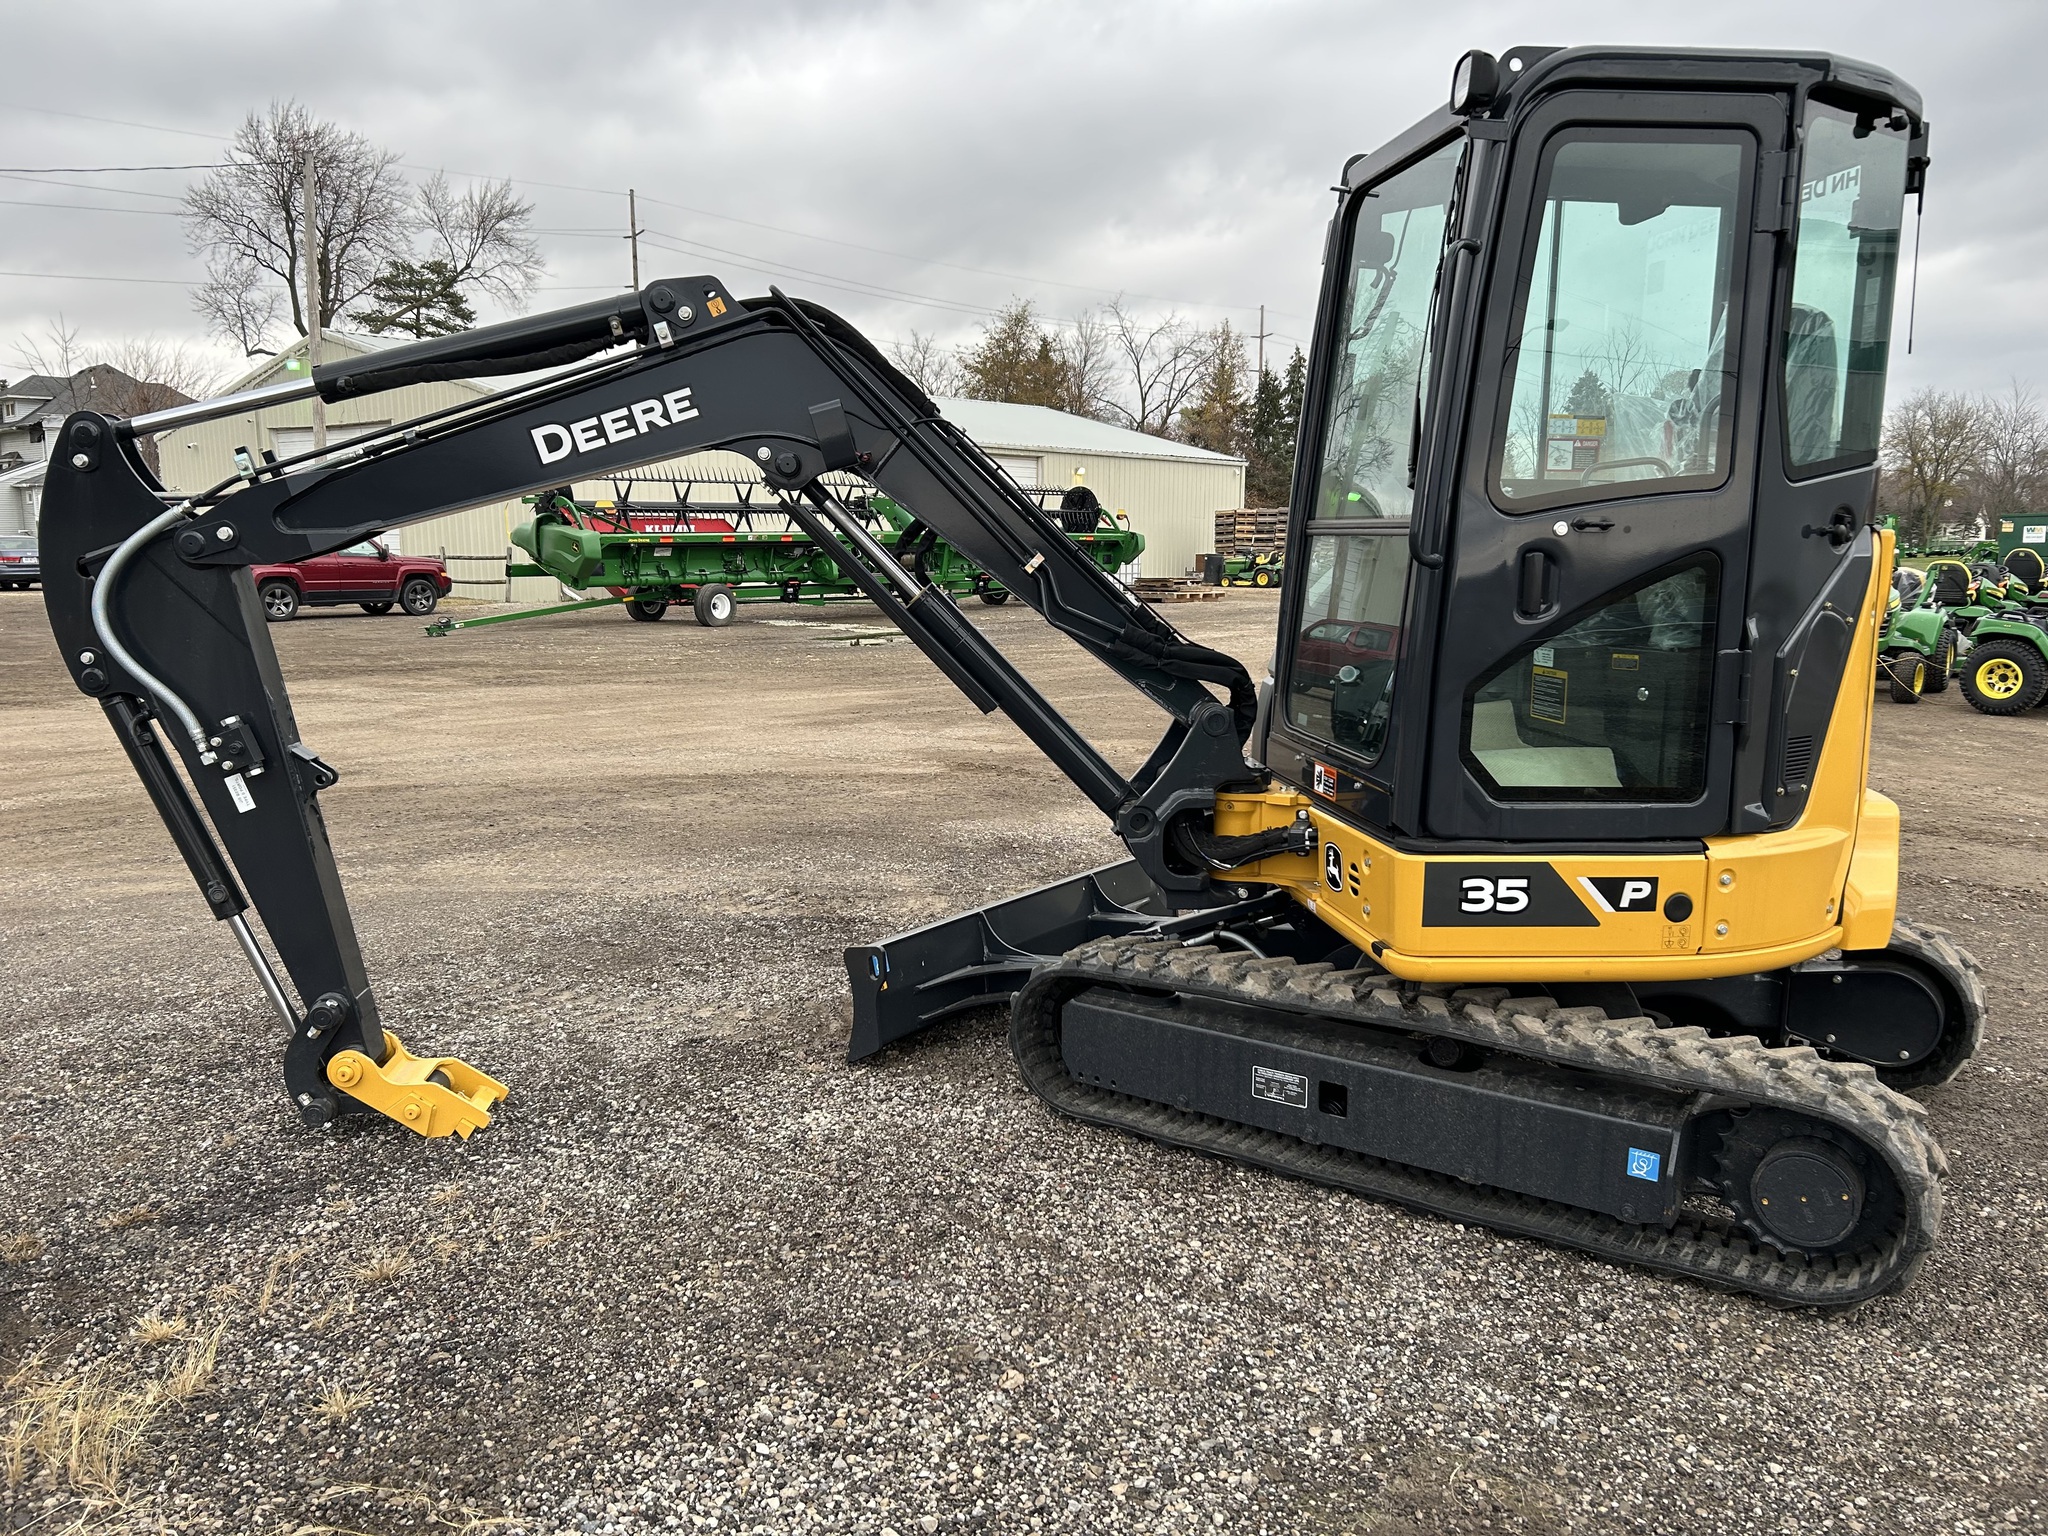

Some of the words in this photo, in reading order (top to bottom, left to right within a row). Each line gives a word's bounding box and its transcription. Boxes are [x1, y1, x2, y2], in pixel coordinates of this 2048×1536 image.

[531, 387, 699, 464] DEERE
[1461, 878, 1529, 912] 35
[1619, 881, 1651, 908] P
